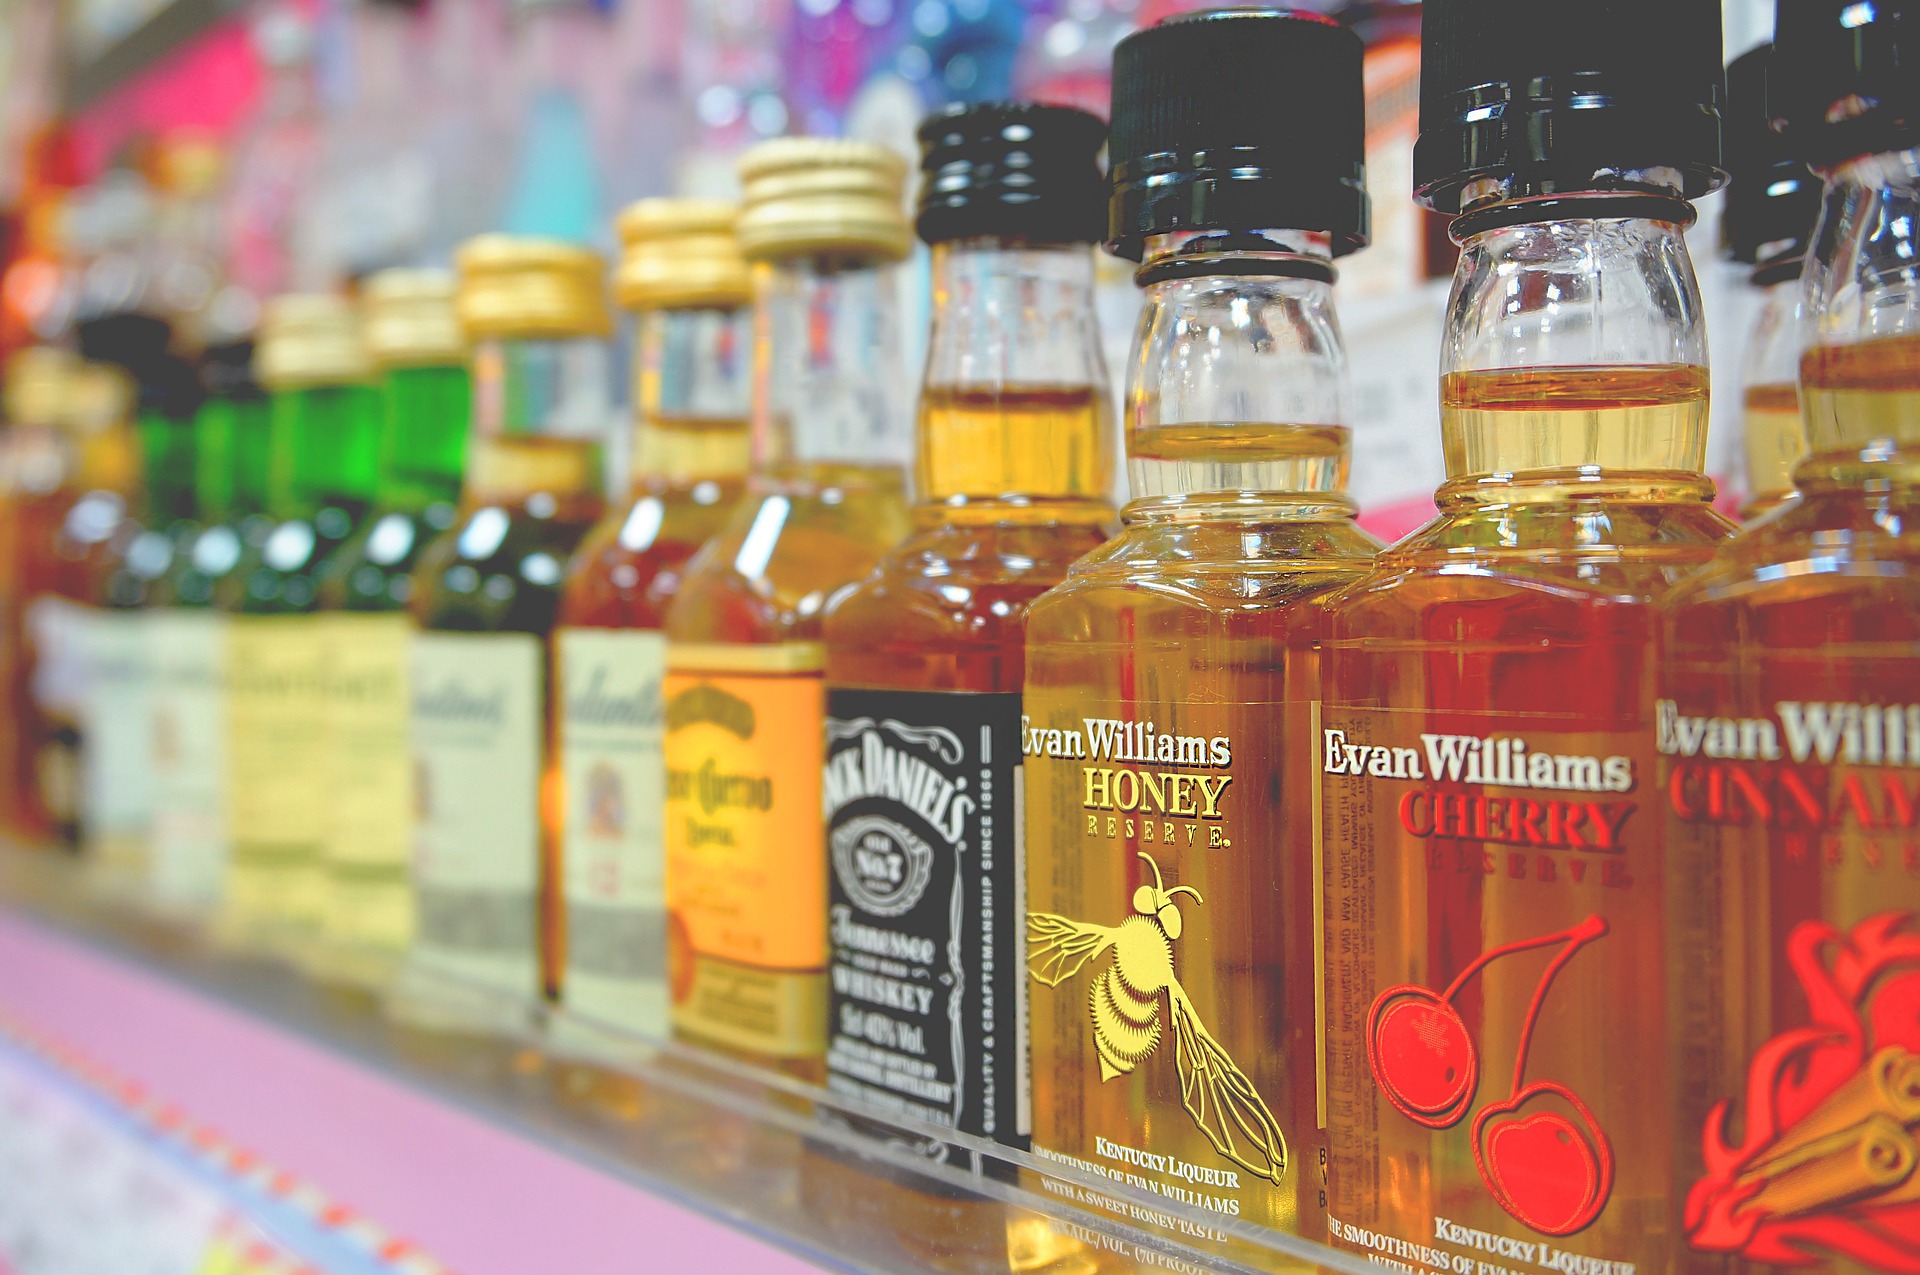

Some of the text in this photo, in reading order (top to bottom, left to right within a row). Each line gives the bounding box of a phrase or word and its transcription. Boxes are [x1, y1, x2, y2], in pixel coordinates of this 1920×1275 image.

[979, 768, 993, 810] 1866
[1083, 767, 1232, 818] HONEY
[980, 815, 993, 870] SINCE
[1400, 790, 1637, 852] CHERRY
[980, 875, 995, 1033] CRAFTSMANSHIP
[1041, 1178, 1075, 1200] WITH
[1076, 1188, 1086, 1203] A
[1085, 1192, 1128, 1216] SWEET
[1129, 1206, 1176, 1231] HONEY
[1177, 1219, 1228, 1243] TASTE
[1160, 1183, 1240, 1216] WILLIAMS
[1343, 1223, 1451, 1270] SMOOTHNESS
